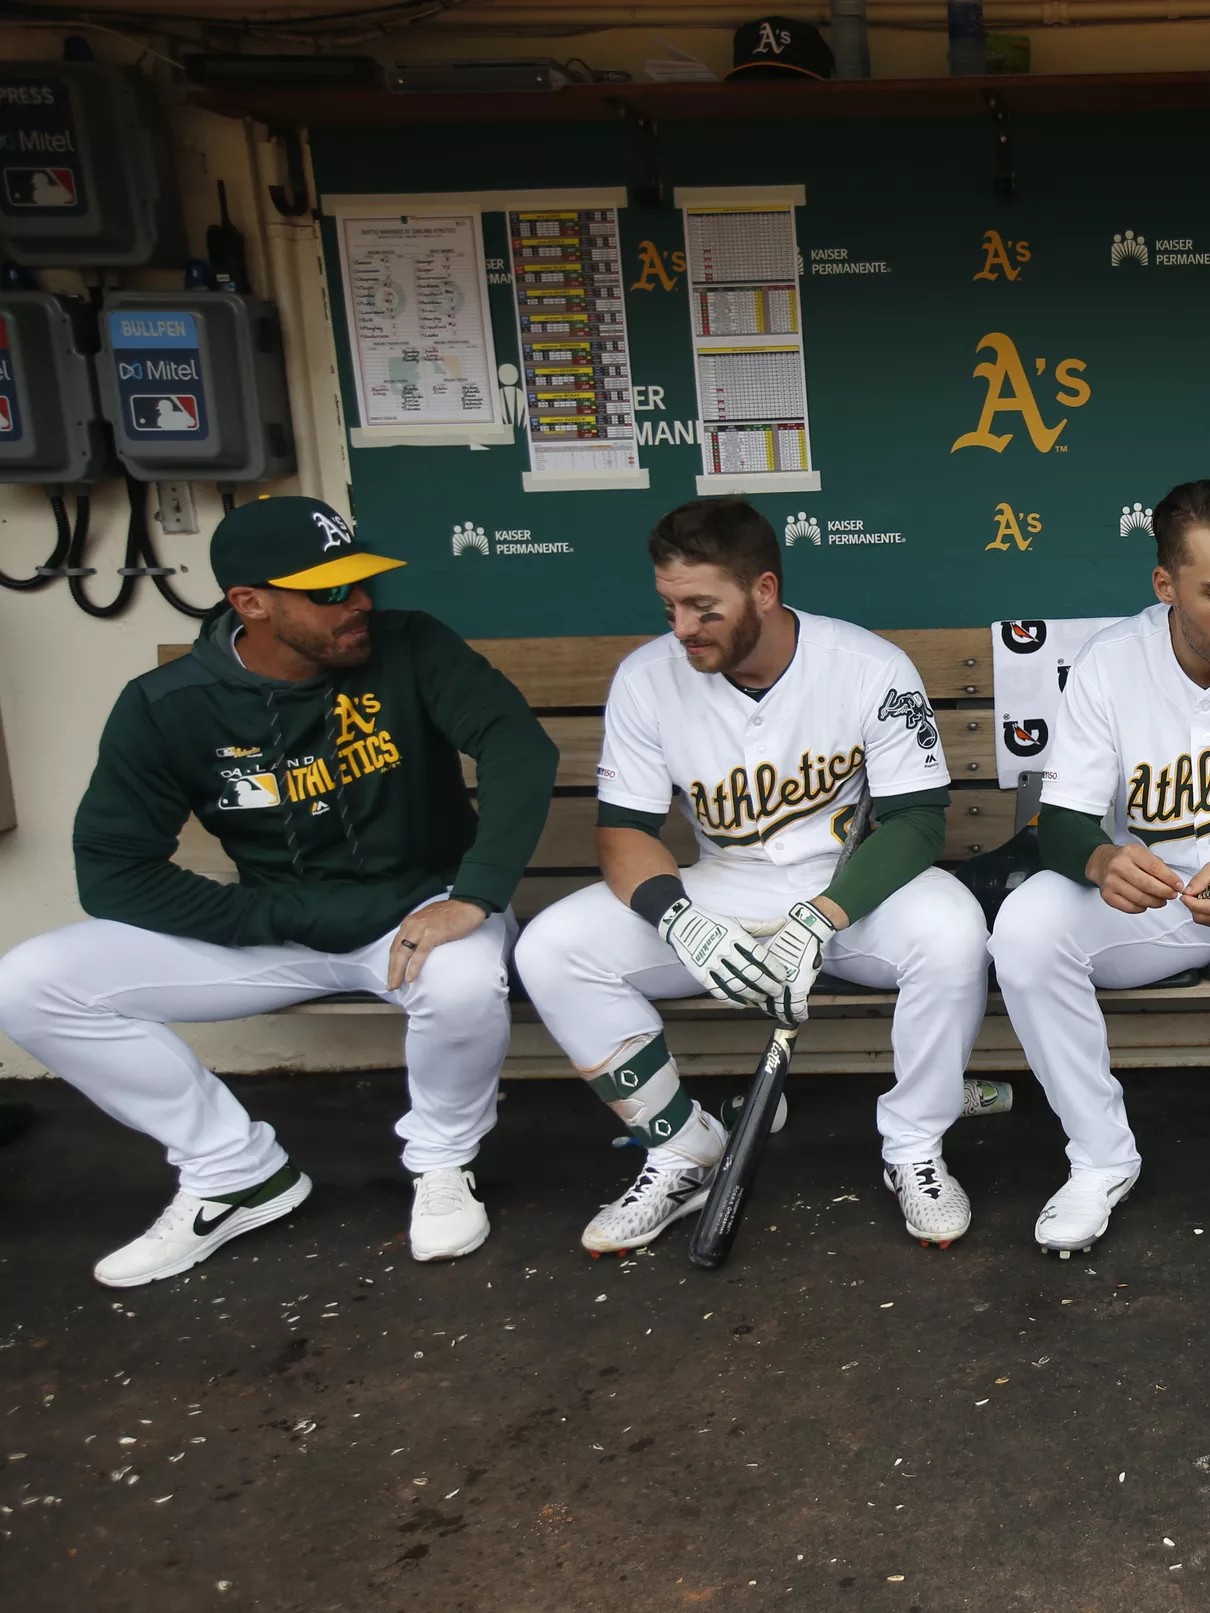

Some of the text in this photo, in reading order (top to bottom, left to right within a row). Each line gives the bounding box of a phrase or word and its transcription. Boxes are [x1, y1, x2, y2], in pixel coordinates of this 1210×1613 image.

[753, 22, 791, 55] A's
[20, 131, 75, 152] Mitel
[811, 248, 848, 261] KAISER
[972, 230, 1032, 281] A's
[1155, 239, 1193, 251] KAISER
[485, 258, 505, 270] SER
[121, 319, 187, 338] BULLPEN
[146, 359, 199, 380] Mitel
[951, 332, 1091, 453] A's
[495, 529, 531, 541] KAISER
[828, 520, 864, 531] KAISER
[985, 503, 1042, 551] A's
[692, 745, 866, 832] Athletics
